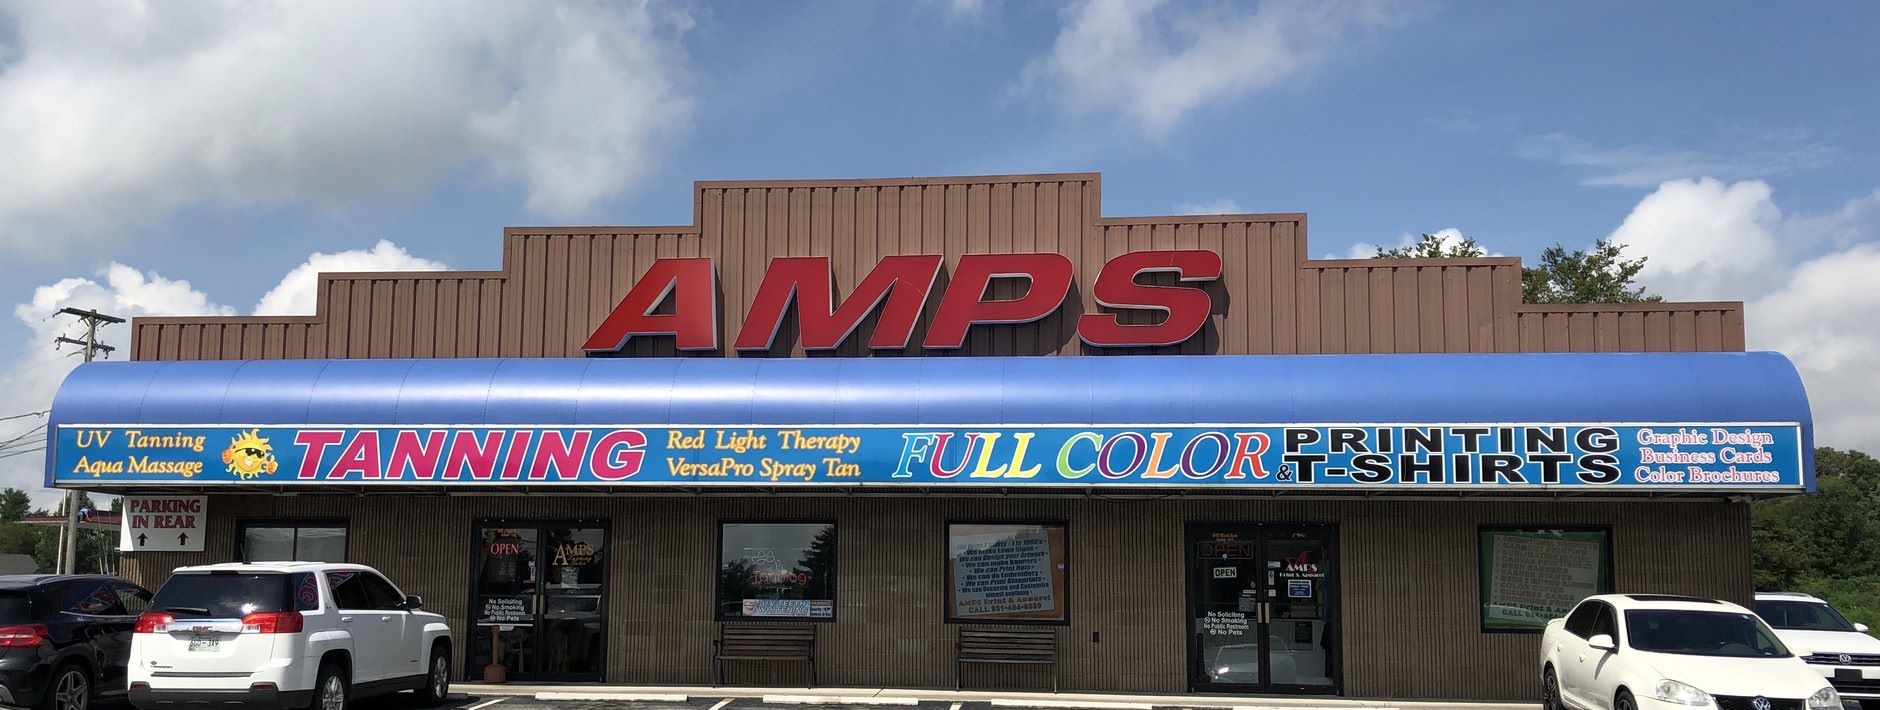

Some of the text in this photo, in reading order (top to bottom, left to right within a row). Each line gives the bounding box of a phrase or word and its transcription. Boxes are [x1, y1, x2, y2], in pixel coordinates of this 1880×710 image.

[582, 249, 1222, 352] AMPS
[75, 430, 206, 453] UV Tanning
[667, 430, 861, 454] Red Light Therapy
[1284, 427, 1621, 455] PRINTING
[1637, 428, 1774, 449] Graphic Design
[293, 430, 647, 481] TANNING
[891, 431, 1272, 480] FULL COLOR
[1640, 446, 1771, 464] Business Cards
[73, 456, 205, 478] Aqua Massage
[667, 457, 862, 482] VersaPro Spray Tan
[1275, 454, 1621, 484] & T-SHIRTS
[1635, 466, 1780, 483] Color Brochures
[130, 499, 201, 513] PARKING
[132, 515, 197, 528] IN REAR
[490, 543, 519, 555] OPEN
[552, 543, 595, 566] AMPS
[1016, 545, 1033, 553] Signs
[983, 553, 1004, 561] Design
[1005, 552, 1019, 560] your
[1215, 568, 1236, 578] OPEN
[1285, 563, 1318, 572] AMPS
[1001, 571, 1039, 579] Embroidery
[1020, 582, 1049, 590] Customize
[1017, 595, 1051, 603] Apparel
[500, 604, 524, 612] Smoking
[969, 605, 990, 613] CALL
[1217, 611, 1245, 619] Soliciting
[1503, 609, 1524, 617] CALL
